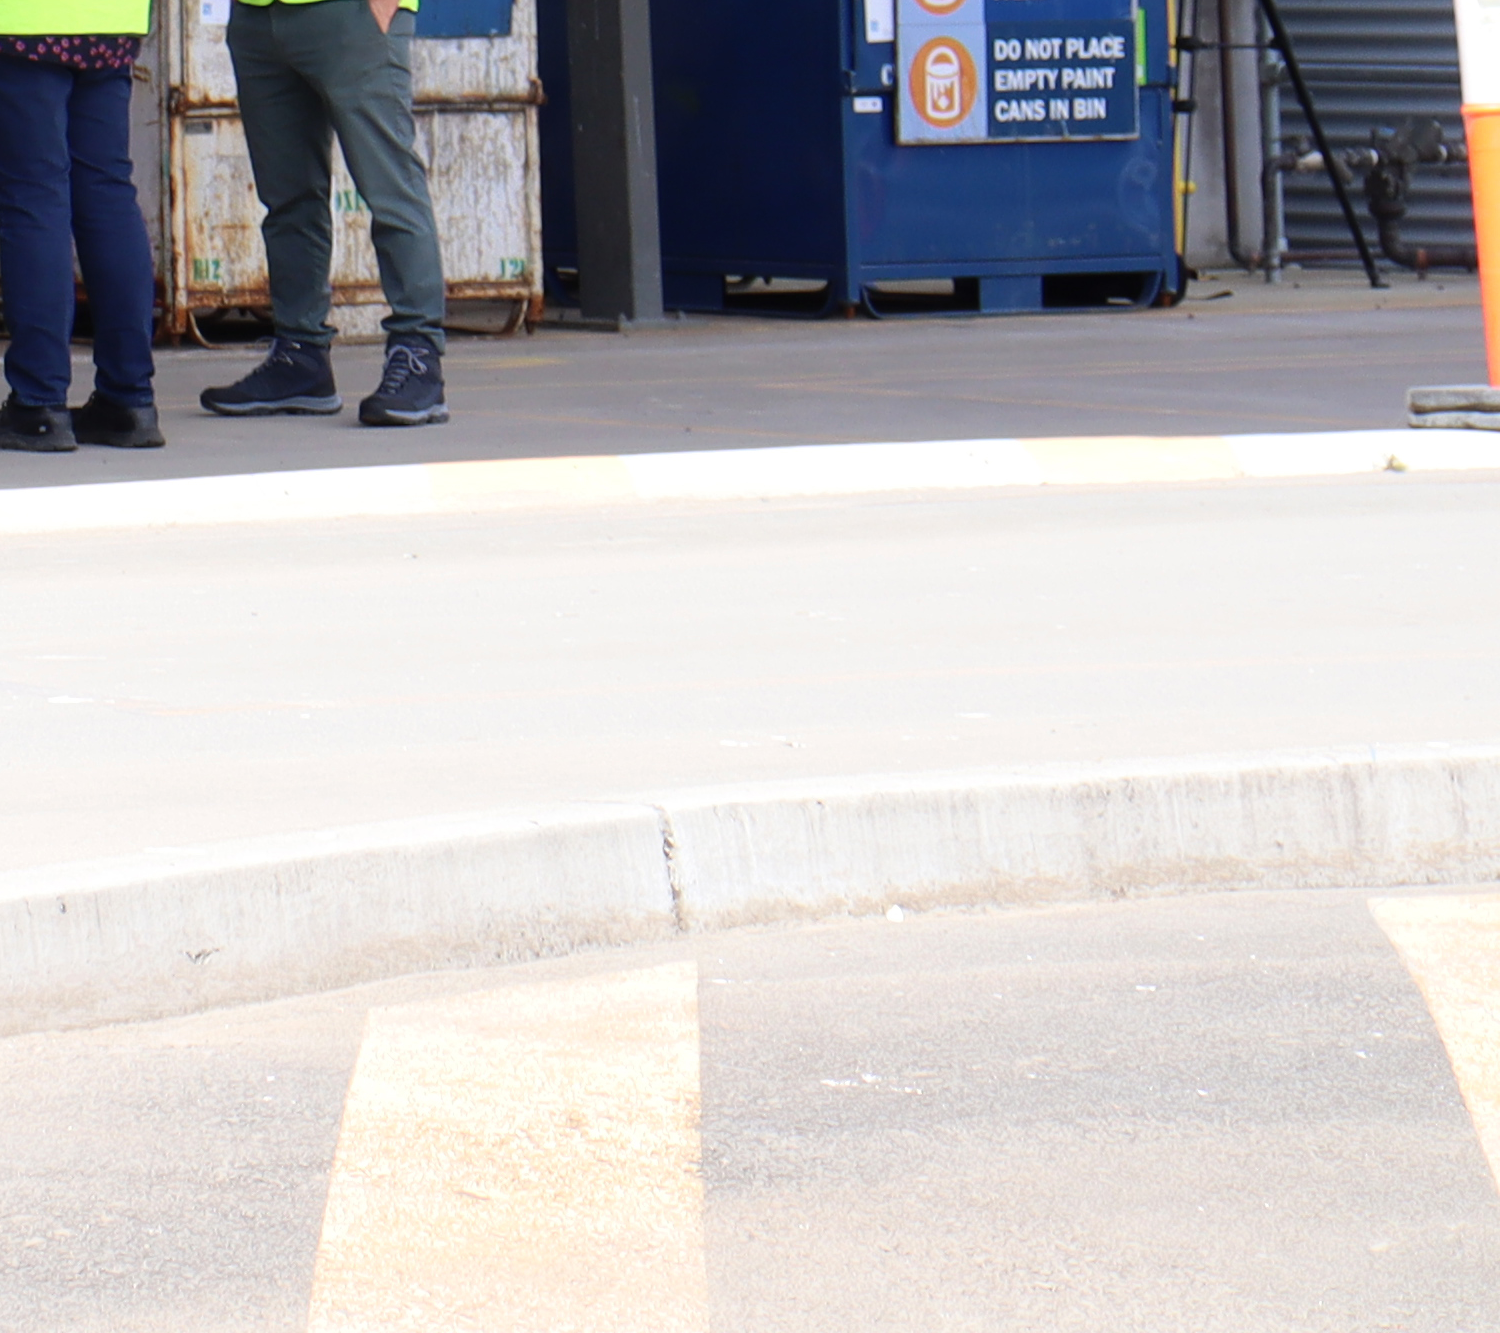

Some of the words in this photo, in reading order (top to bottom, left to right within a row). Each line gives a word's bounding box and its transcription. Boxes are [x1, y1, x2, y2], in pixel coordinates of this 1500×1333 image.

[993, 38, 1022, 61] DO
[1026, 38, 1062, 60] NOT
[1065, 37, 1125, 59] PLACE
[994, 69, 1059, 92] EMPTY
[1062, 67, 1115, 90] PAINT
[994, 100, 1046, 123] CANS
[1050, 99, 1070, 121] IN
[1073, 98, 1106, 120] BIN
